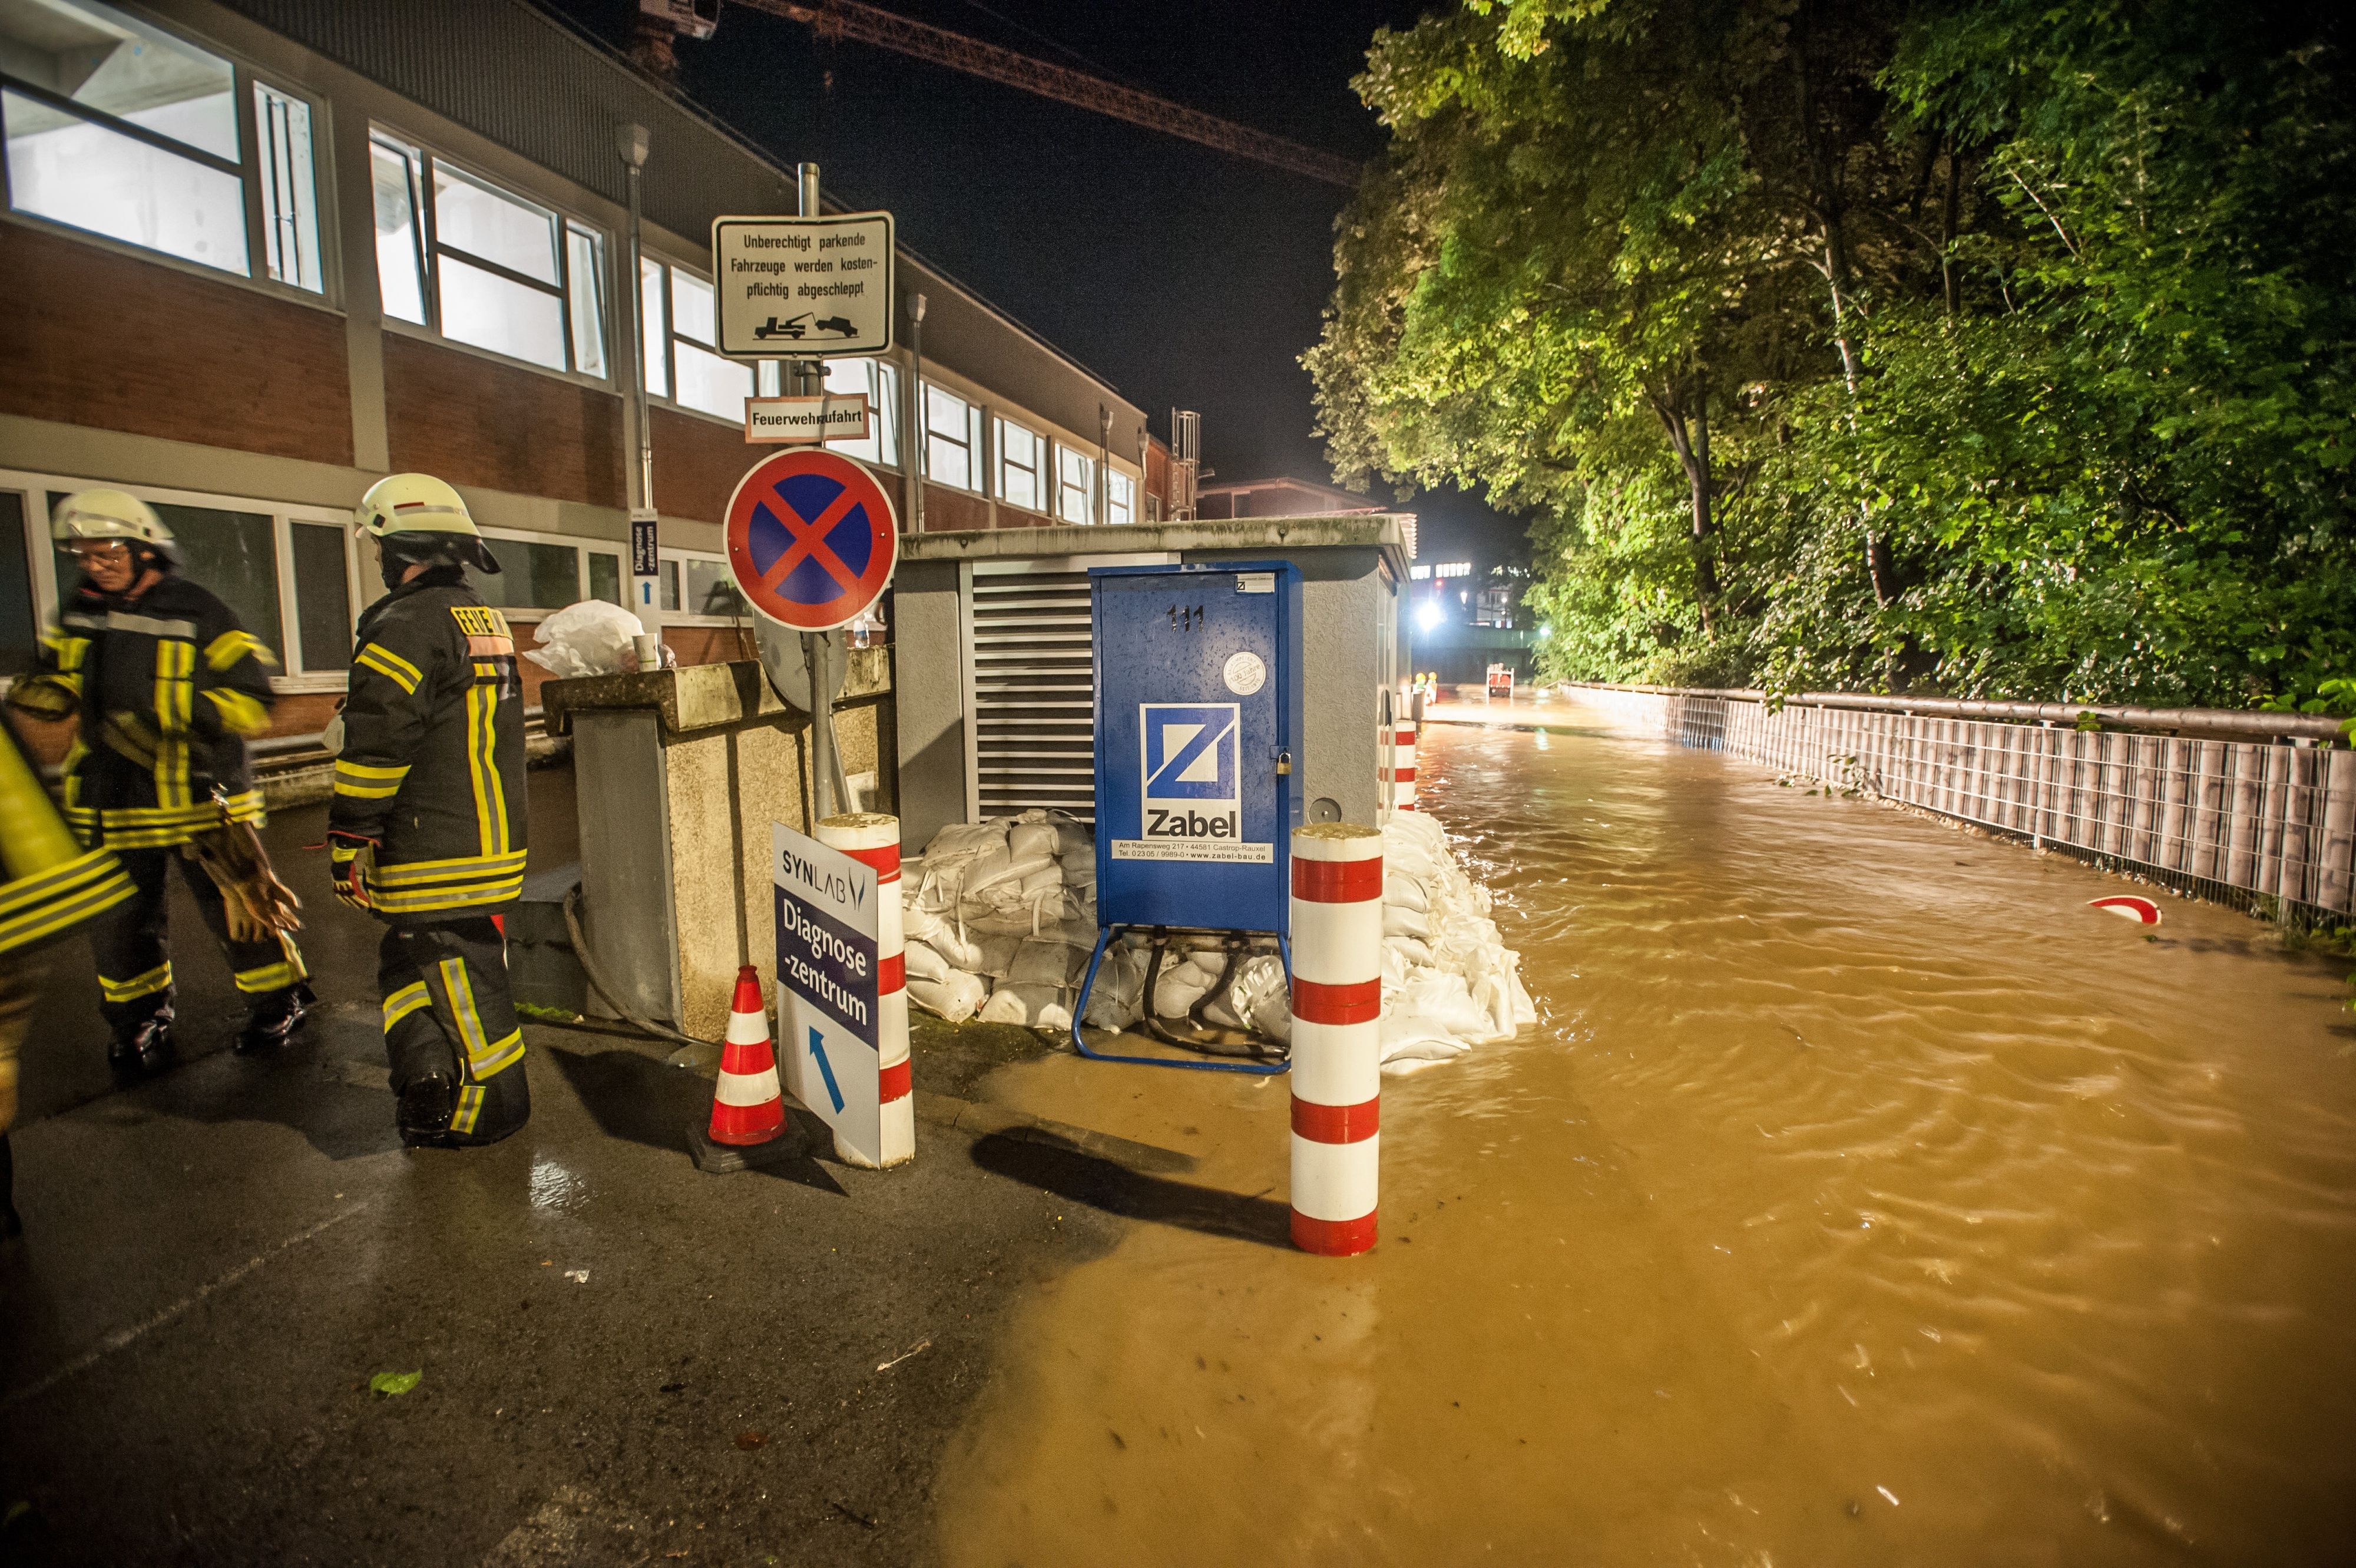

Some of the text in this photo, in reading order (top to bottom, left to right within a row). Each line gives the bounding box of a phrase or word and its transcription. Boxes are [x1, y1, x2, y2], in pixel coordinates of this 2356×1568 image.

[744, 232, 866, 252] Unberechtigt parkende
[731, 257, 878, 276] Fahrzeuge werden kosten-
[746, 280, 864, 300] pflichtig abgeschleppt
[752, 409, 862, 425] Feuerwehrzufahrt
[635, 526, 646, 572] Diagnose
[1166, 604, 1205, 633] 111
[1244, 664, 1260, 677] Jahre
[1147, 809, 1236, 838] Zabel
[1131, 842, 1170, 851] Rapensweg
[1213, 844, 1266, 852] Castrop-Rauxel
[782, 849, 846, 904] SYNLAB
[783, 898, 867, 977] Diagnose
[785, 953, 867, 1026] -zentrum
